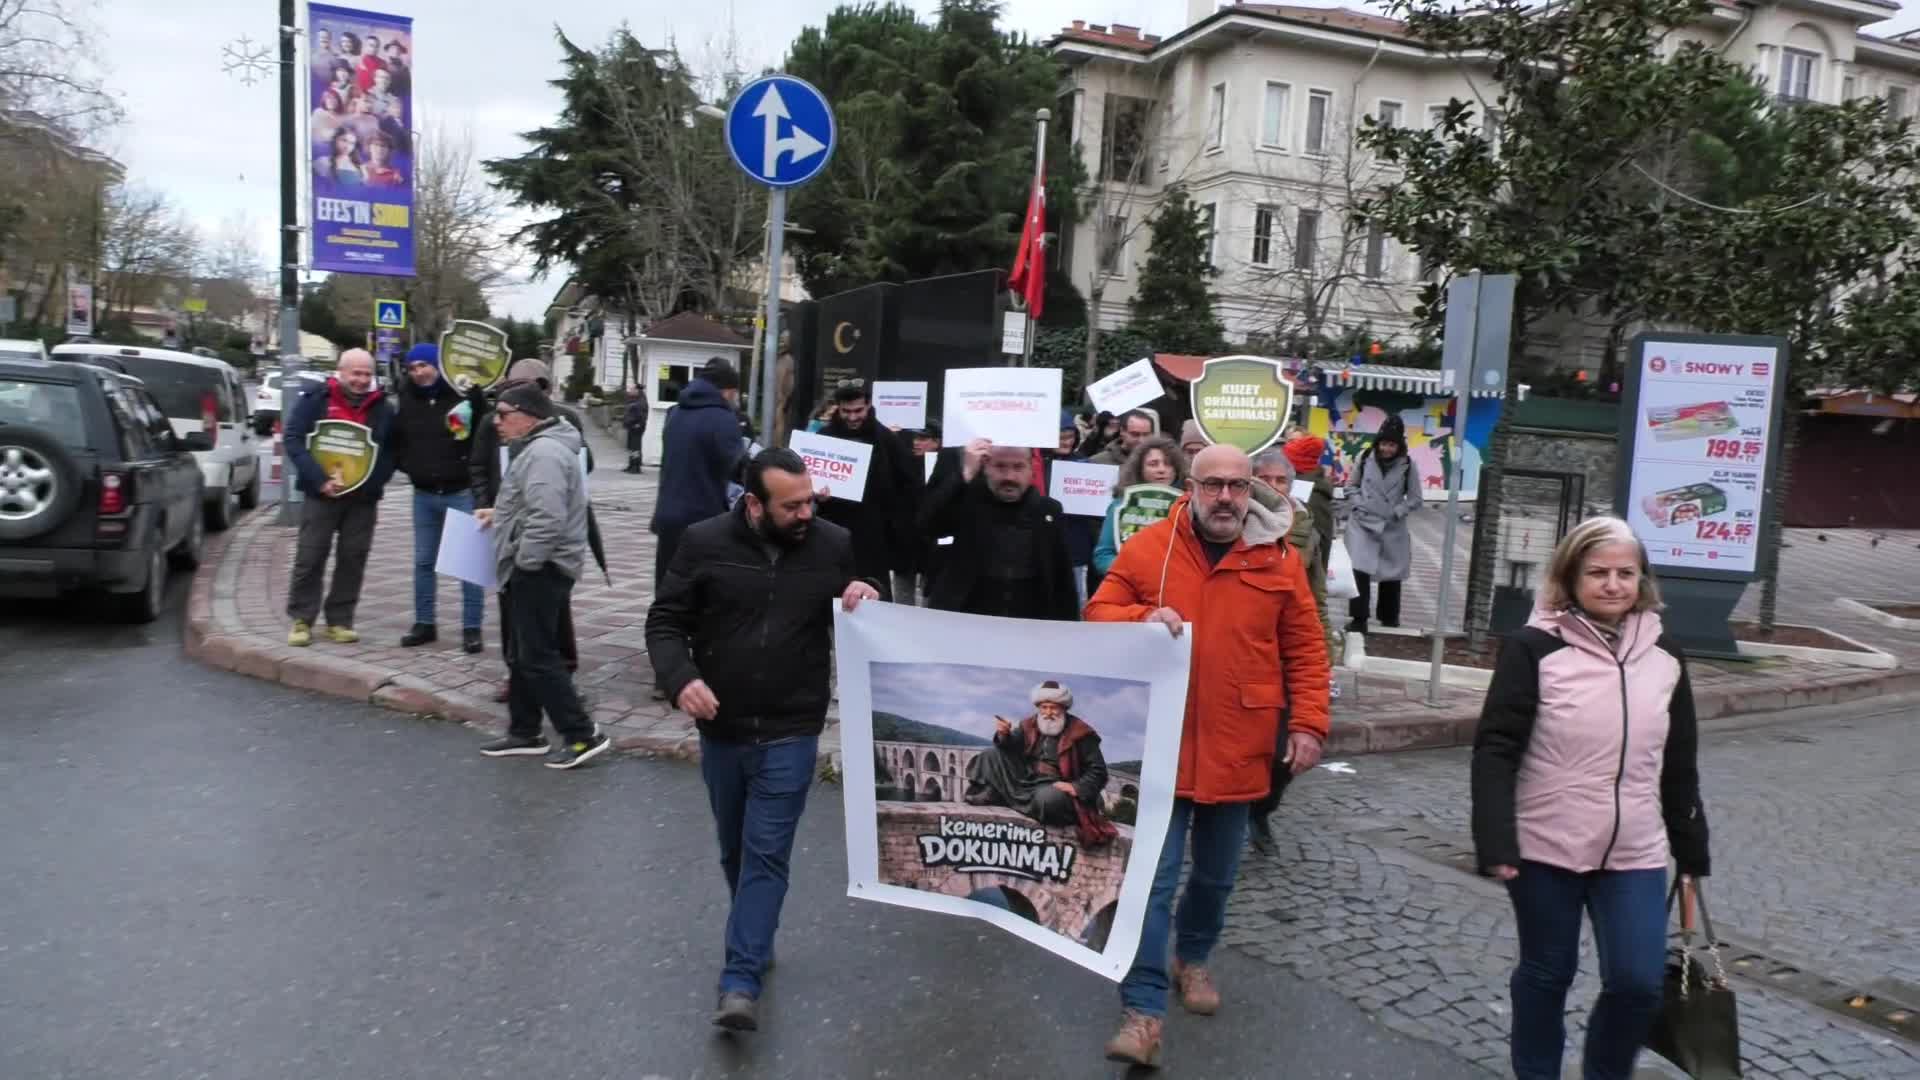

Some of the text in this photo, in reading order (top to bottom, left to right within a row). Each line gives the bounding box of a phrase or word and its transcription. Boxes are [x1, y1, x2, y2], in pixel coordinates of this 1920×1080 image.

[1685, 361, 1744, 375] SNOWY
[1221, 384, 1261, 396] KUZEY
[1203, 396, 1278, 408] ORMANLARI
[1203, 408, 1278, 421] SAVUNMASI
[803, 455, 853, 475] BETON
[940, 816, 1045, 844] kemerime
[920, 836, 1074, 879] DOKUNMA!
